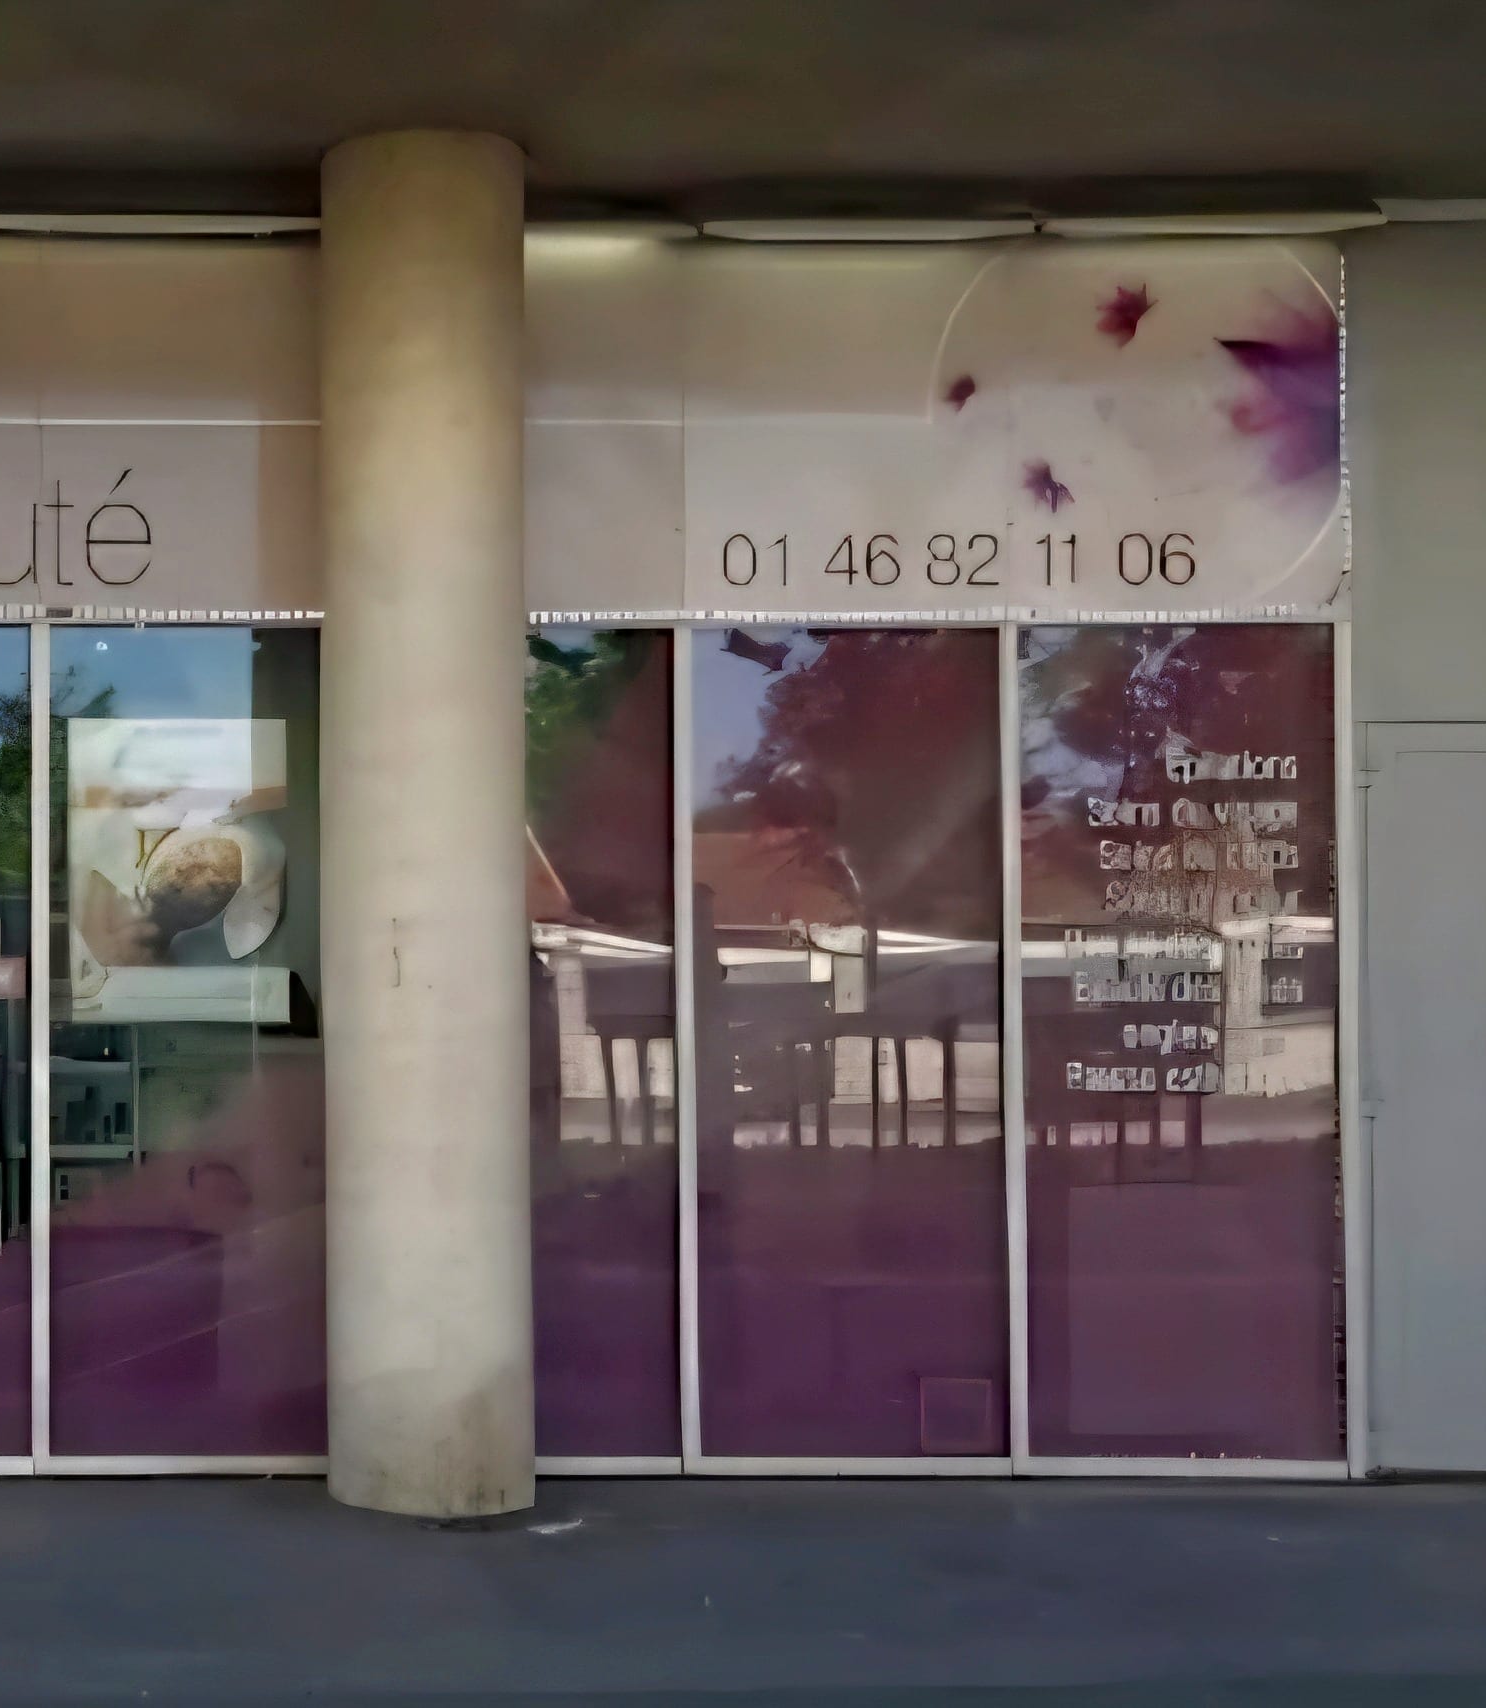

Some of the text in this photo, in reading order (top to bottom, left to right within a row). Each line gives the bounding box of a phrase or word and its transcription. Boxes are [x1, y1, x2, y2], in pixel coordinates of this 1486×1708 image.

[722, 533, 1196, 587] 01 46 82 11 06
